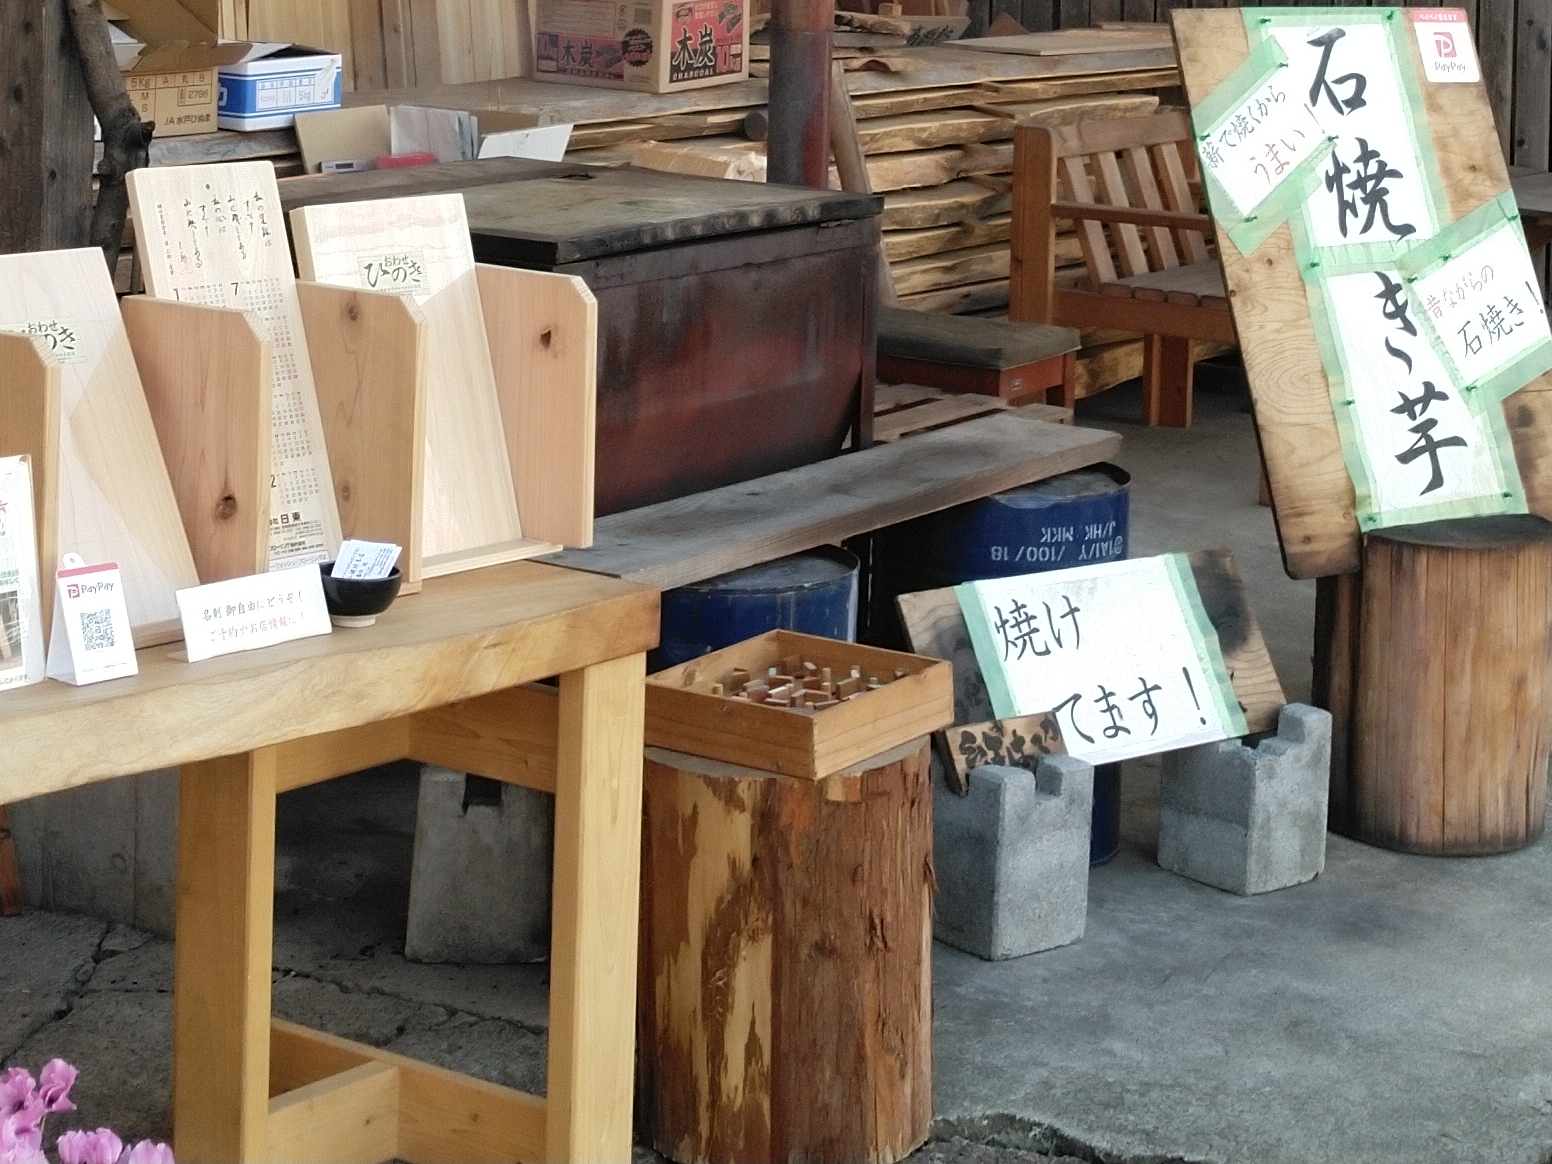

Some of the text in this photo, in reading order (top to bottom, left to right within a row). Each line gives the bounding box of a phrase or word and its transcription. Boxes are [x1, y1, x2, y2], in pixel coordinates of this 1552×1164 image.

[559, 39, 595, 70] 木炭
[672, 22, 715, 71] 木炭
[1202, 85, 1286, 169] 薪で焼くから
[363, 260, 422, 288] ひのき
[384, 254, 409, 268] おわせ
[1427, 265, 1494, 319] 昔ながらの
[27, 320, 58, 334] おわせ
[81, 582, 114, 594] PayPay
[993, 594, 1082, 662] 焼け
